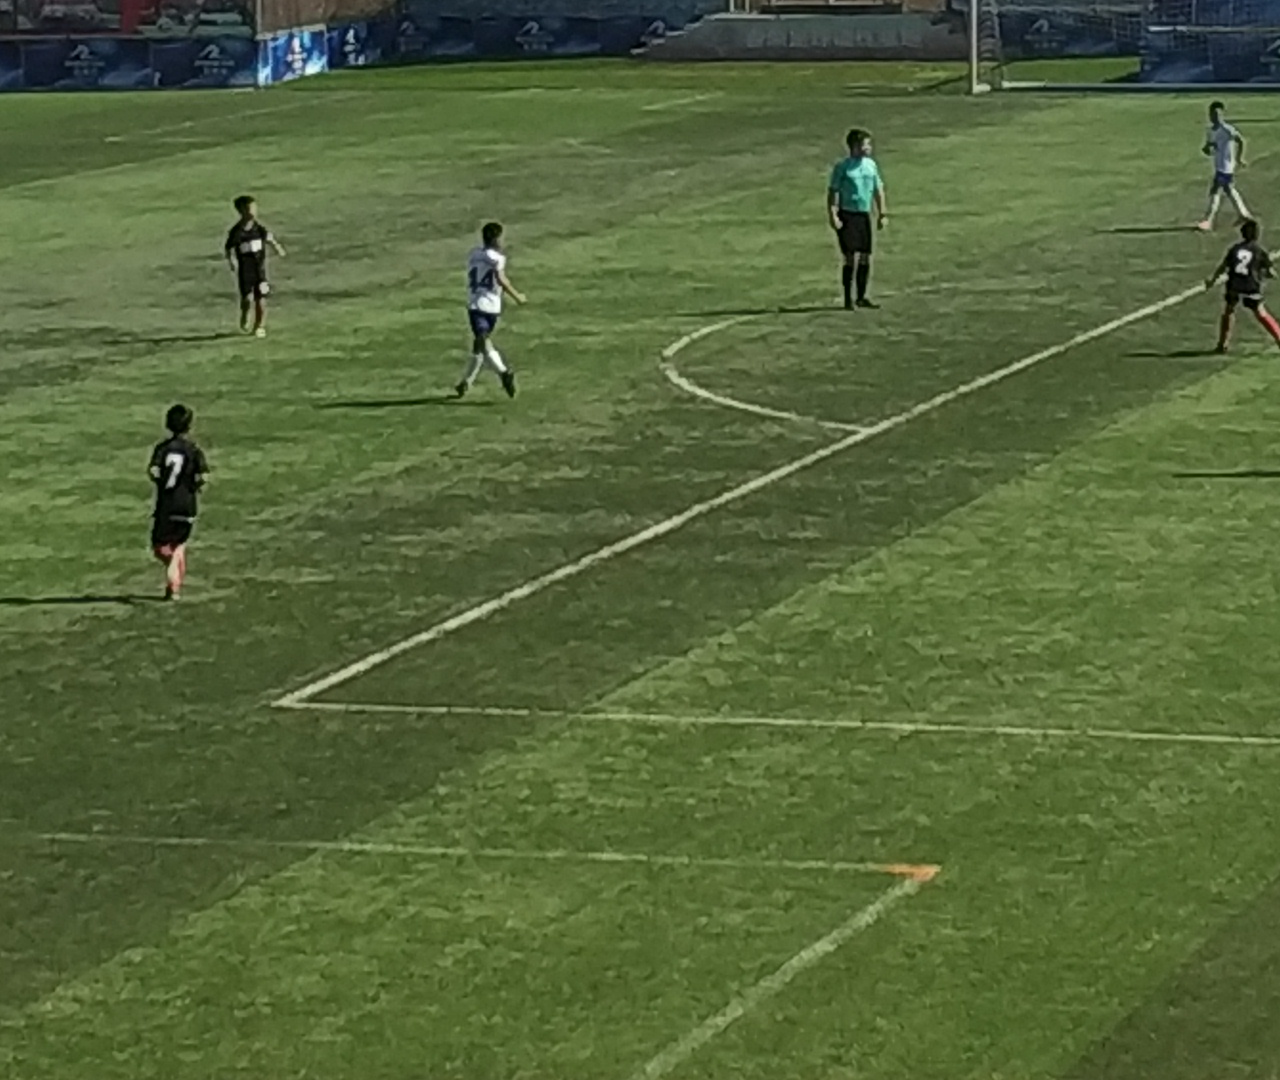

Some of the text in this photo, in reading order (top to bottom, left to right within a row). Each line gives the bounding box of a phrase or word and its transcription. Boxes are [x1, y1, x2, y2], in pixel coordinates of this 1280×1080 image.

[1235, 249, 1253, 275] 2
[468, 266, 495, 294] 14
[165, 453, 185, 489] 7
